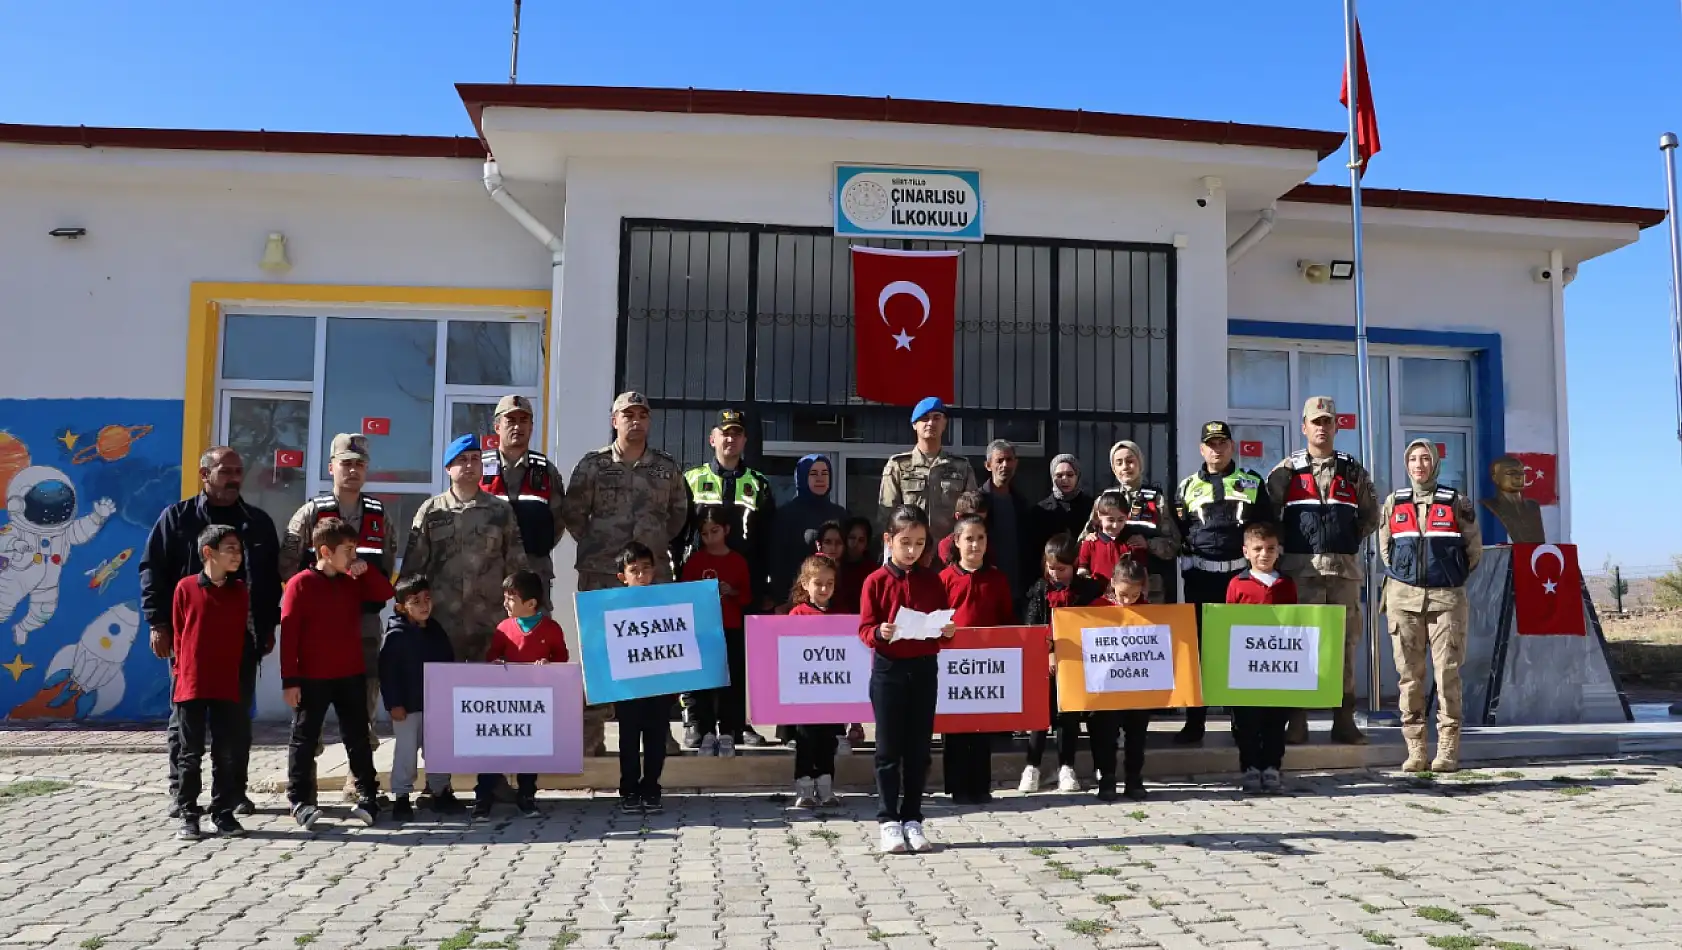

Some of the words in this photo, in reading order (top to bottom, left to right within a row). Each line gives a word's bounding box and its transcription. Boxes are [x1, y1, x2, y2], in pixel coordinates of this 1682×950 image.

[891, 188, 966, 205] ÇINARLISU
[891, 205, 968, 227] İLKOKULU
[613, 616, 687, 638] YAŞAMA
[1095, 636, 1118, 648] HER
[1121, 635, 1159, 649] ÇOCUK
[1246, 635, 1303, 651] SAĞLIK
[627, 643, 684, 663] HAKKI
[802, 646, 846, 662] OYUN
[1090, 649, 1166, 663] HAKLARIYLA
[947, 658, 1006, 675] EĞİTİM
[1109, 666, 1149, 679] DOĞAR
[1248, 660, 1299, 674] HAKKI
[798, 670, 852, 685] HAKKI
[947, 685, 1005, 701] HAKKI
[461, 700, 546, 715] KORUNMA
[475, 723, 532, 738] HAKKI
